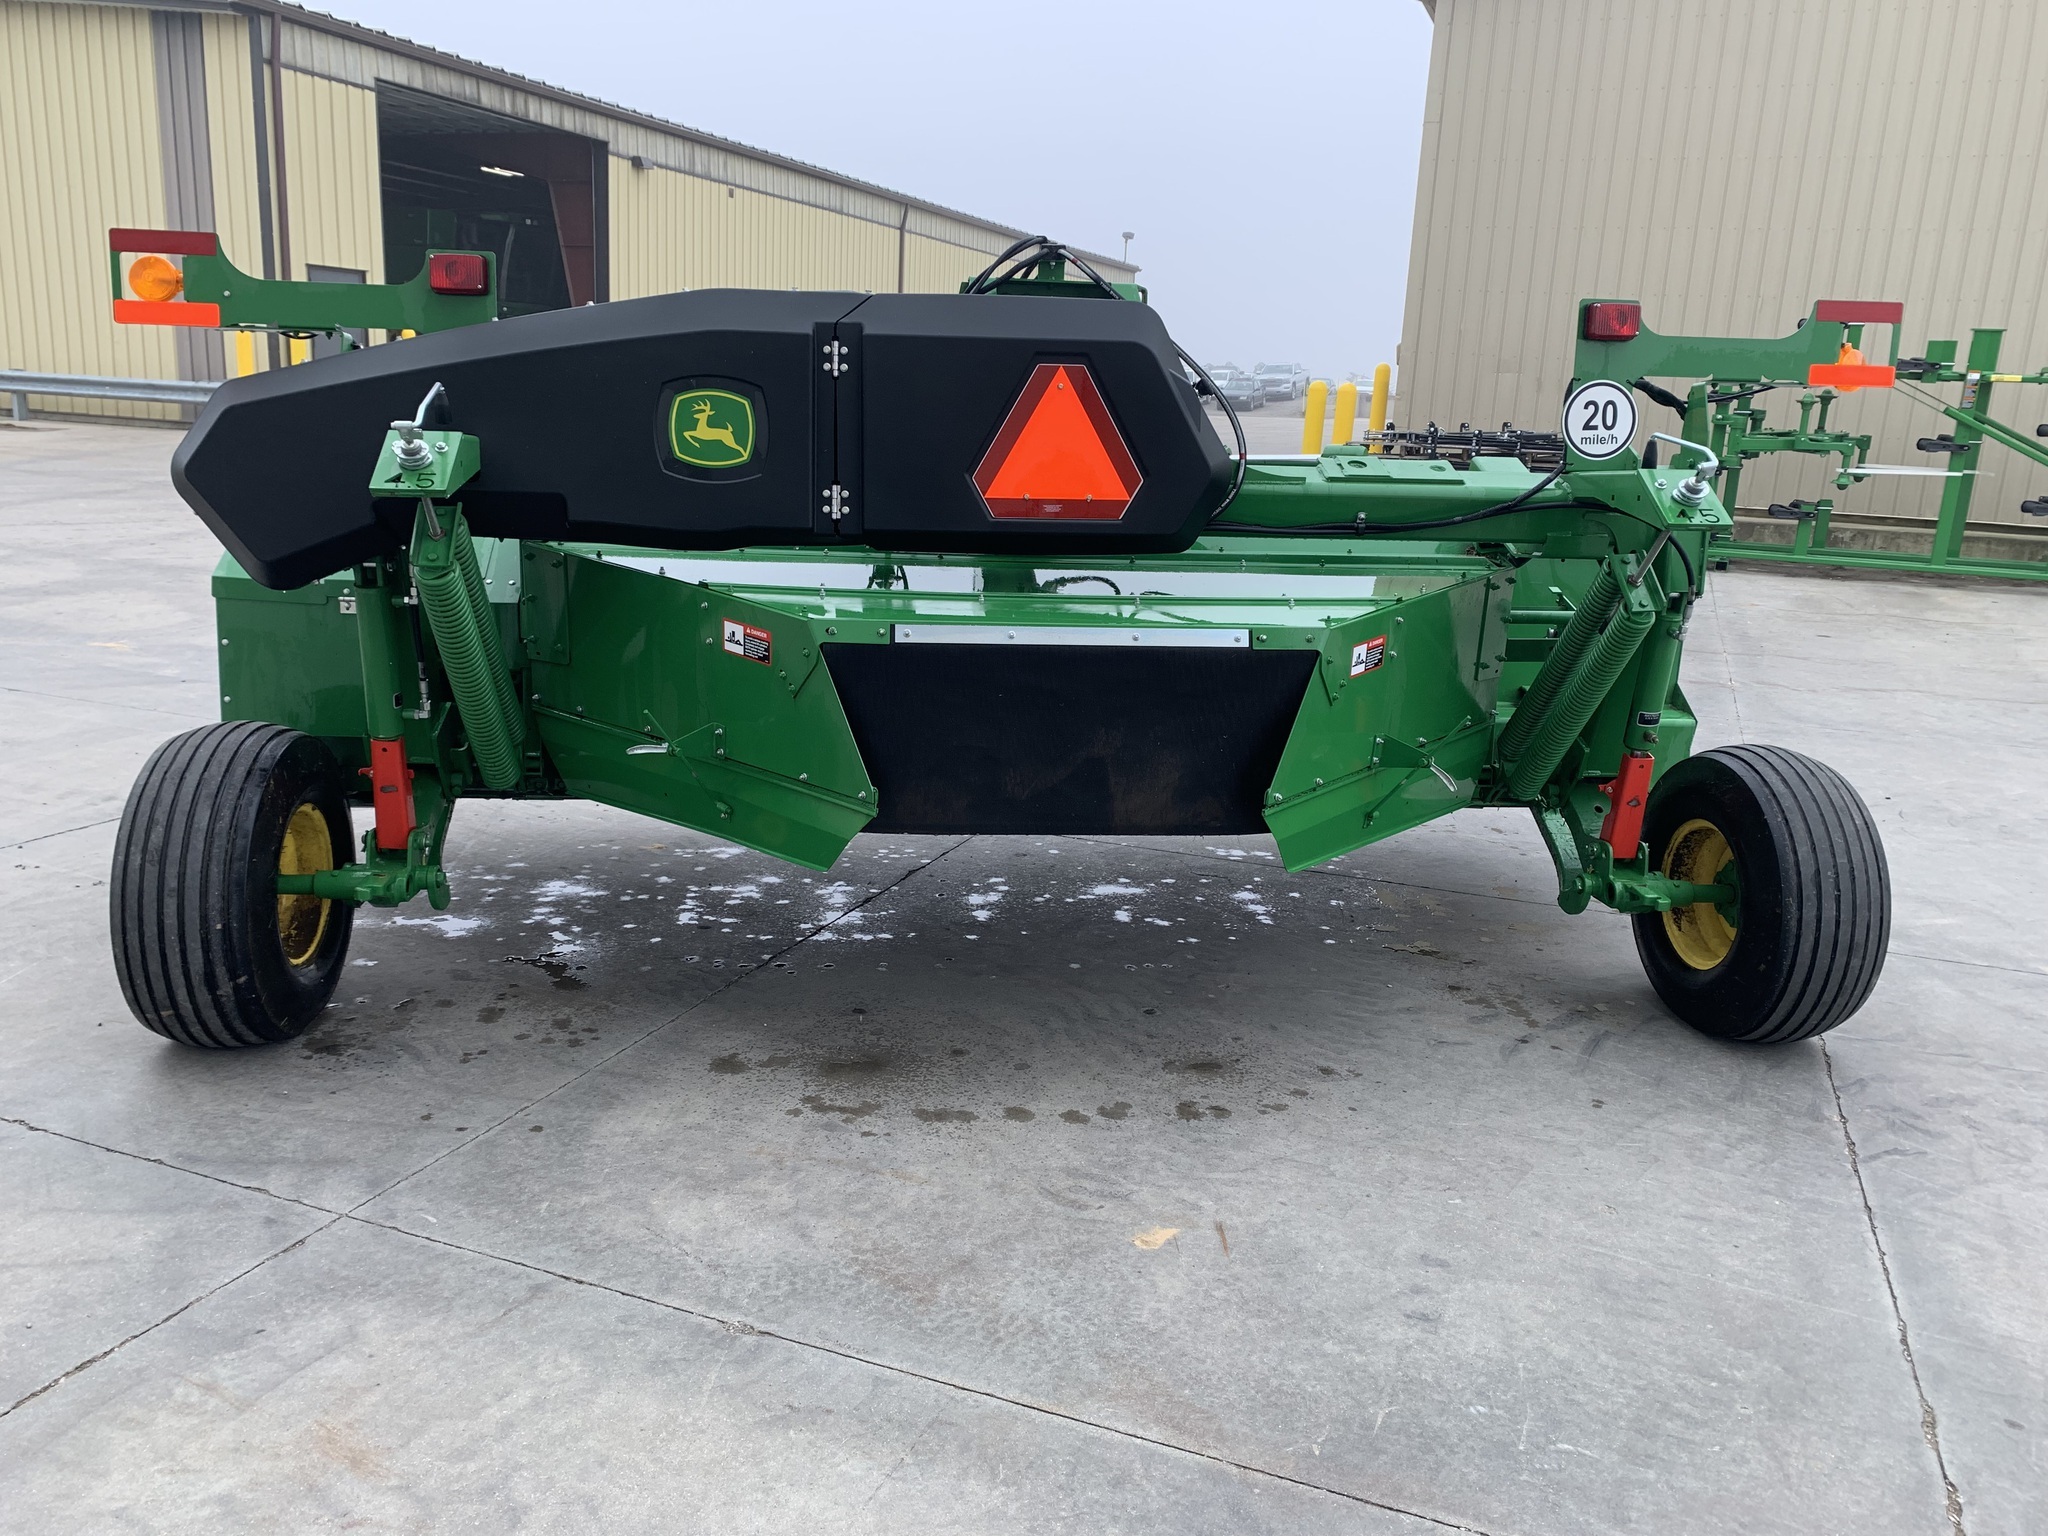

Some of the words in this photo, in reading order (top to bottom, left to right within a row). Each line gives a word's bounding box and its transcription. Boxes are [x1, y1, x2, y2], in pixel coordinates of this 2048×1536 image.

[1581, 399, 1618, 431] 20
[1580, 434, 1618, 445] mile/h
[384, 472, 437, 488] 4.5
[1676, 508, 1720, 524] 4.5
[751, 628, 768, 639] DANGER
